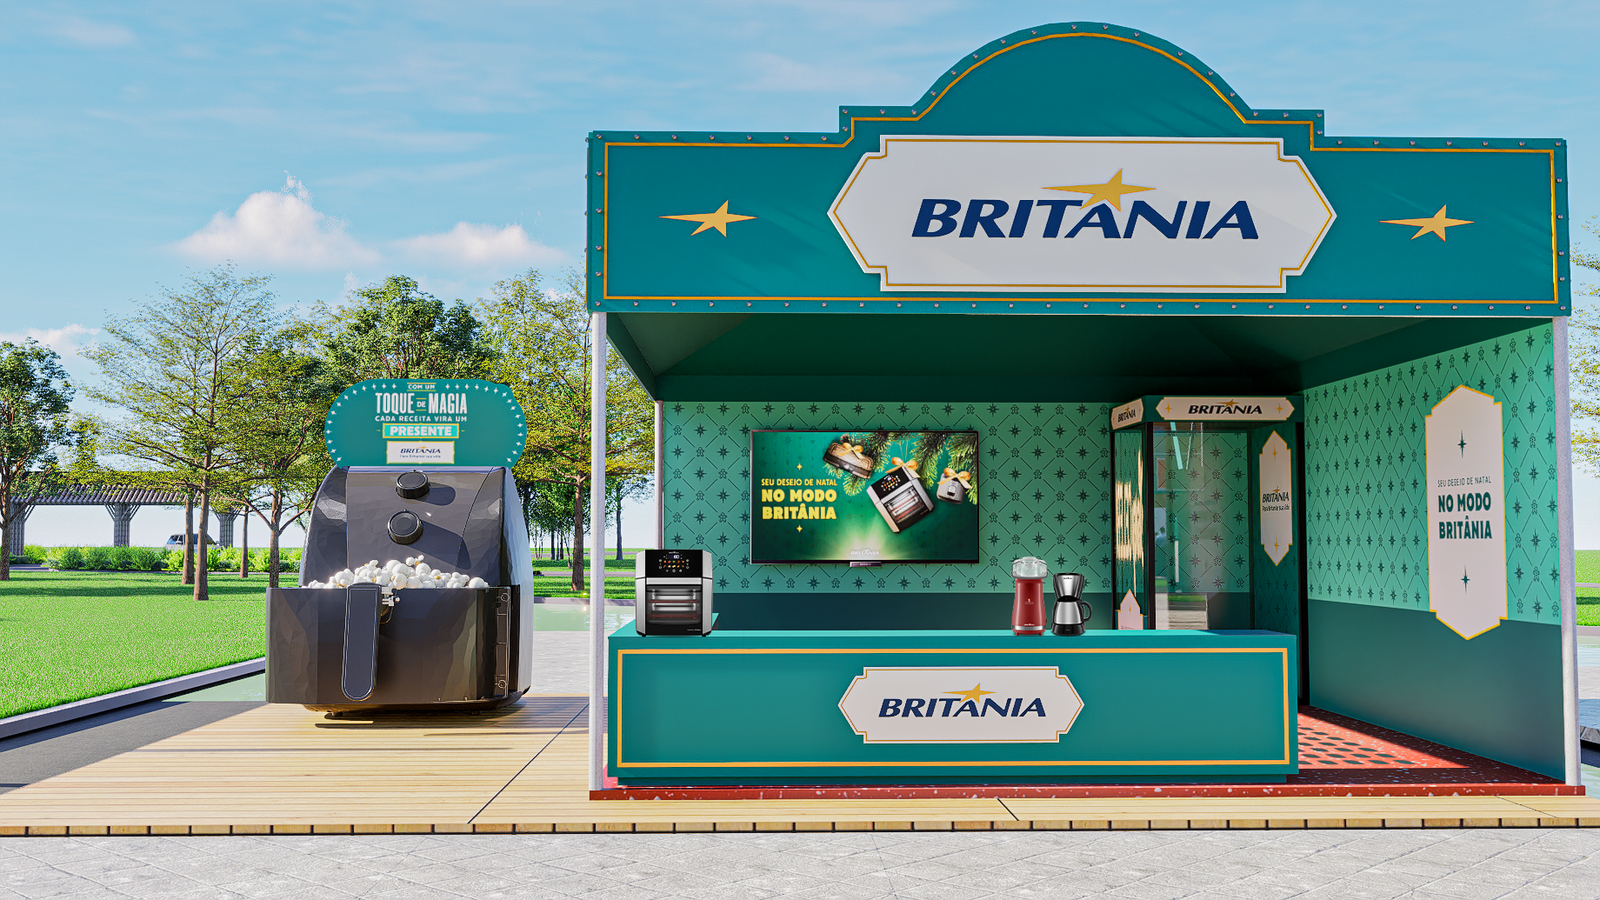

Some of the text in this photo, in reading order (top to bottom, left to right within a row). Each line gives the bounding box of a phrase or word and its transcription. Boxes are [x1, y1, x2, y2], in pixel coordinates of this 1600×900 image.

[375, 392, 415, 415] TOQUE
[428, 392, 468, 414] MAGIA
[389, 426, 452, 436] PRESENTE
[761, 478, 838, 486] SEU DESEJO DE NATAL
[1437, 476, 1491, 488] SEU DESEJO DE NATAL
[761, 488, 837, 502] NO MODO
[1438, 491, 1491, 513] NO MODO
[762, 503, 837, 520] BRITÂNIA
[1438, 515, 1493, 540] BRITÂNIA
